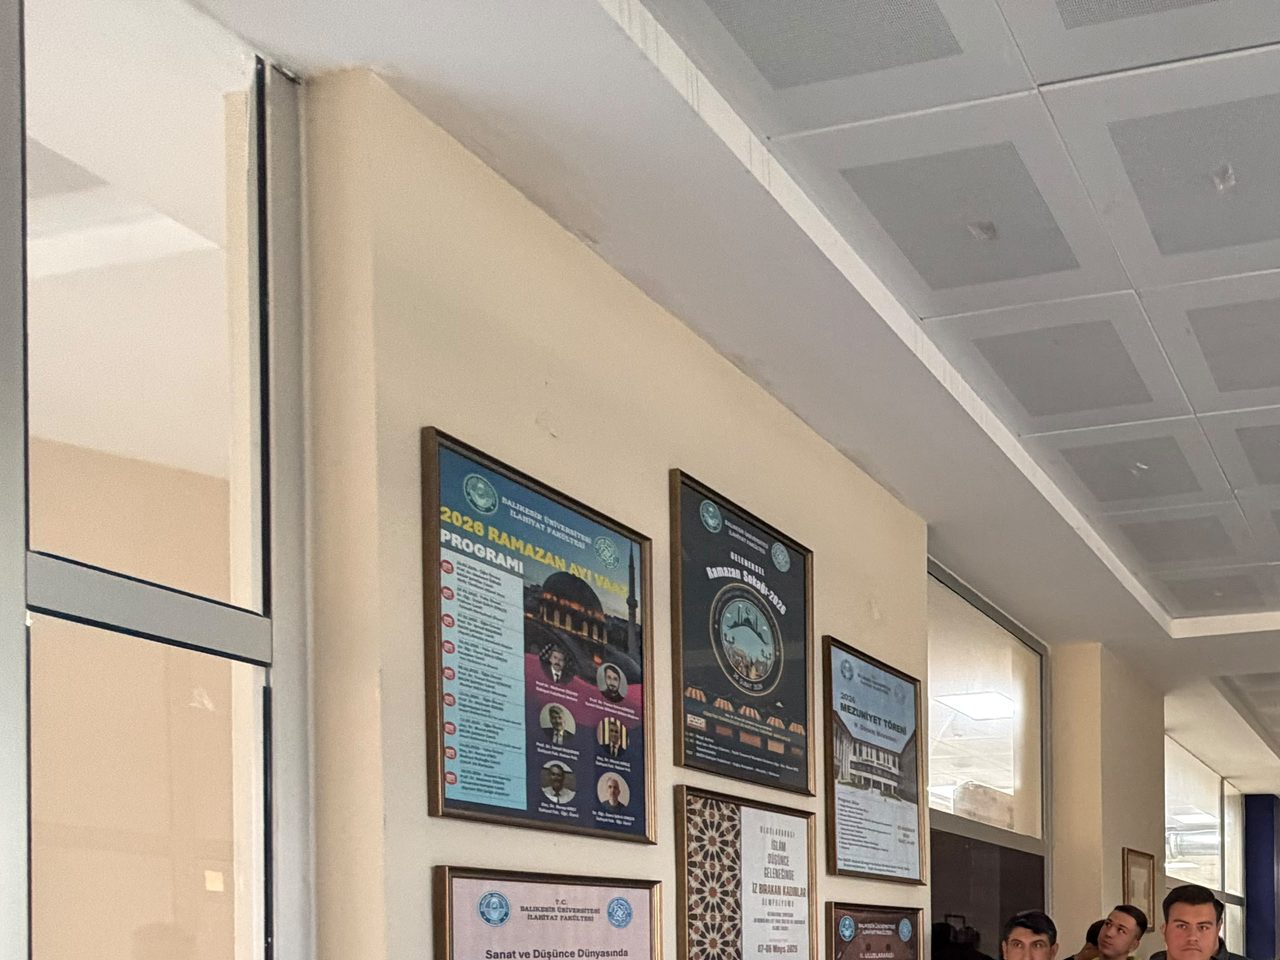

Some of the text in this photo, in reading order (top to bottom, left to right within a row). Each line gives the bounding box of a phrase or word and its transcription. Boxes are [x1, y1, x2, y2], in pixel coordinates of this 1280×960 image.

[440, 529, 524, 575] PROGRAMI
[488, 525, 566, 571] RAMAZAN
[569, 563, 592, 582] AYI
[705, 567, 742, 580] Ramazan
[840, 702, 907, 736] MEZUNİYET TÖRENİ
[520, 905, 600, 915] BALIKESİR ÜNİVERSİTESİ
[527, 913, 594, 922] İLAHİYAT FAKÜLTESİ
[485, 948, 629, 960] Sanat ve Düşünce Dünyasında
